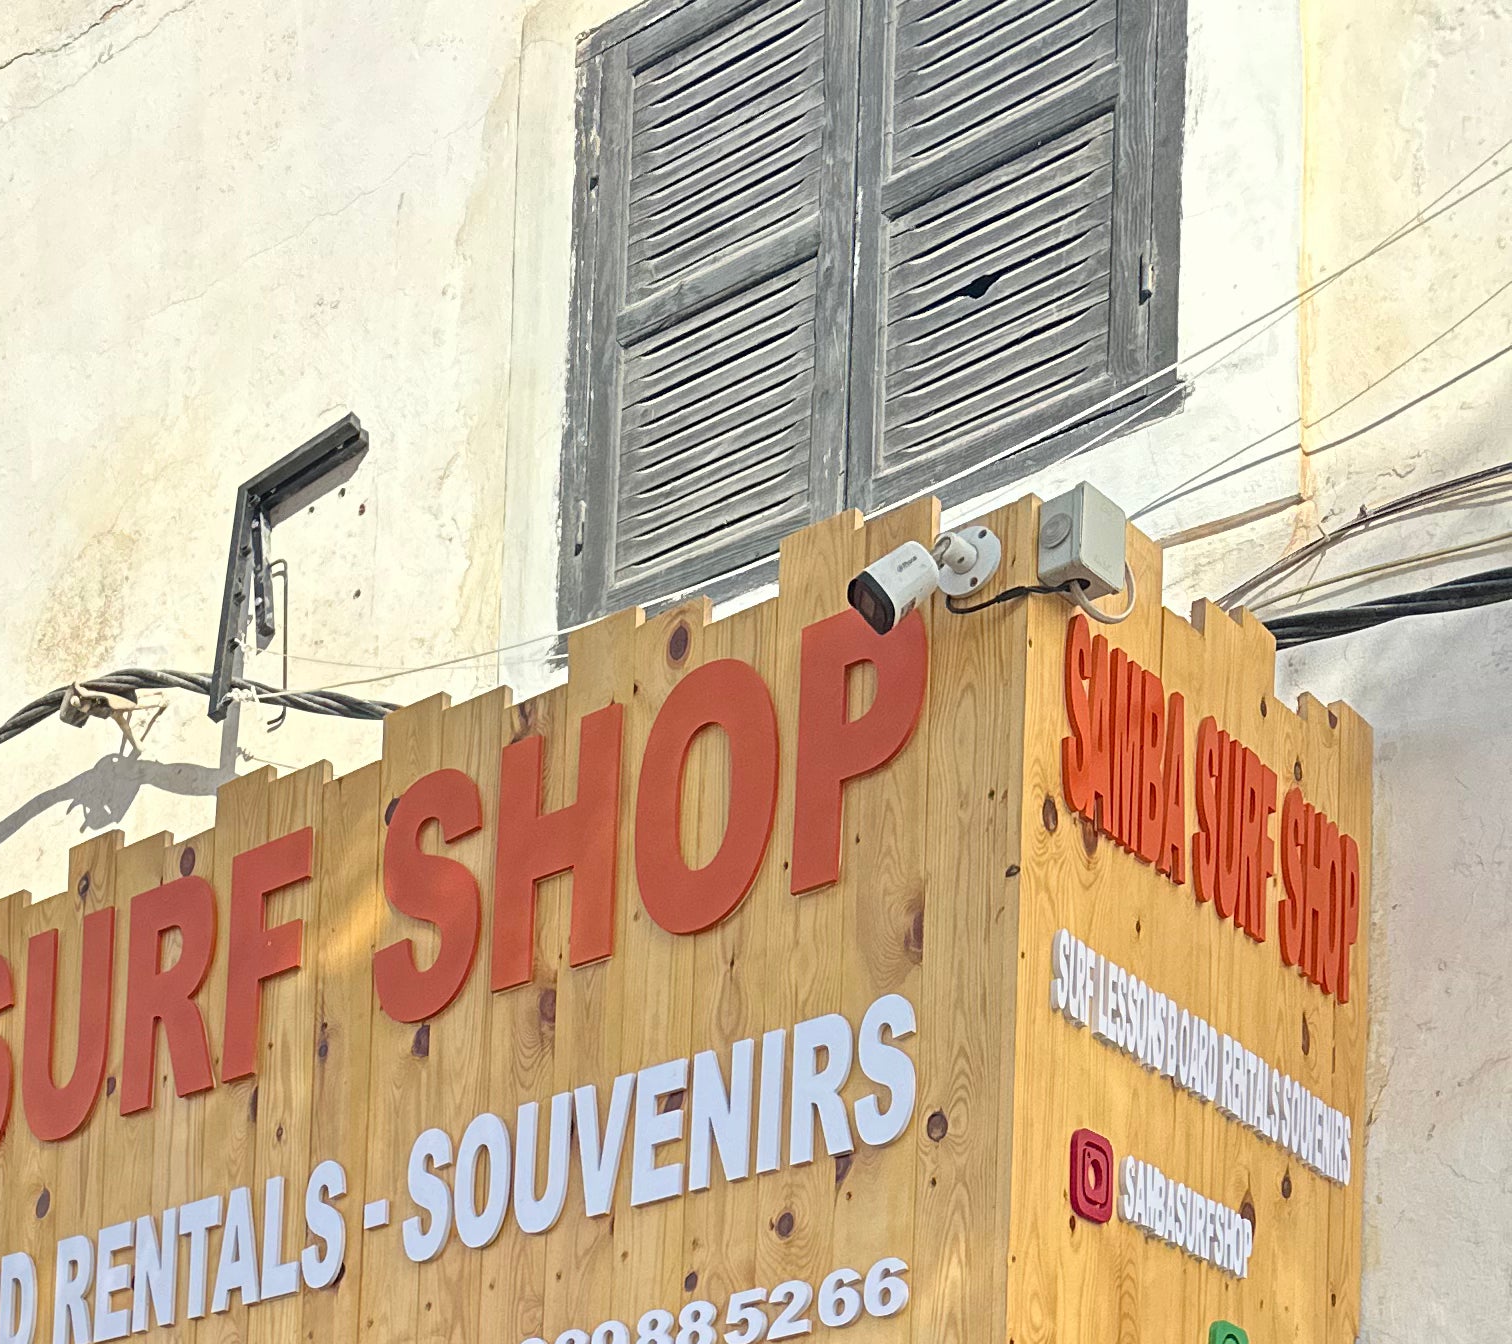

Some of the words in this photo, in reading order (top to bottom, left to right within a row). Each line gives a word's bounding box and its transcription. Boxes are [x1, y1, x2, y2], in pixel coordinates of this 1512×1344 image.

[373, 605, 928, 1023] SHOP
[1062, 613, 1185, 885] SAMBA
[1192, 715, 1277, 943] SURF
[1279, 787, 1359, 1004] SHOP
[1051, 928, 1095, 1028] SURF
[402, 993, 917, 1263] SOUVENIRS
[1117, 1155, 1252, 1279] SAMBASURFSHOP
